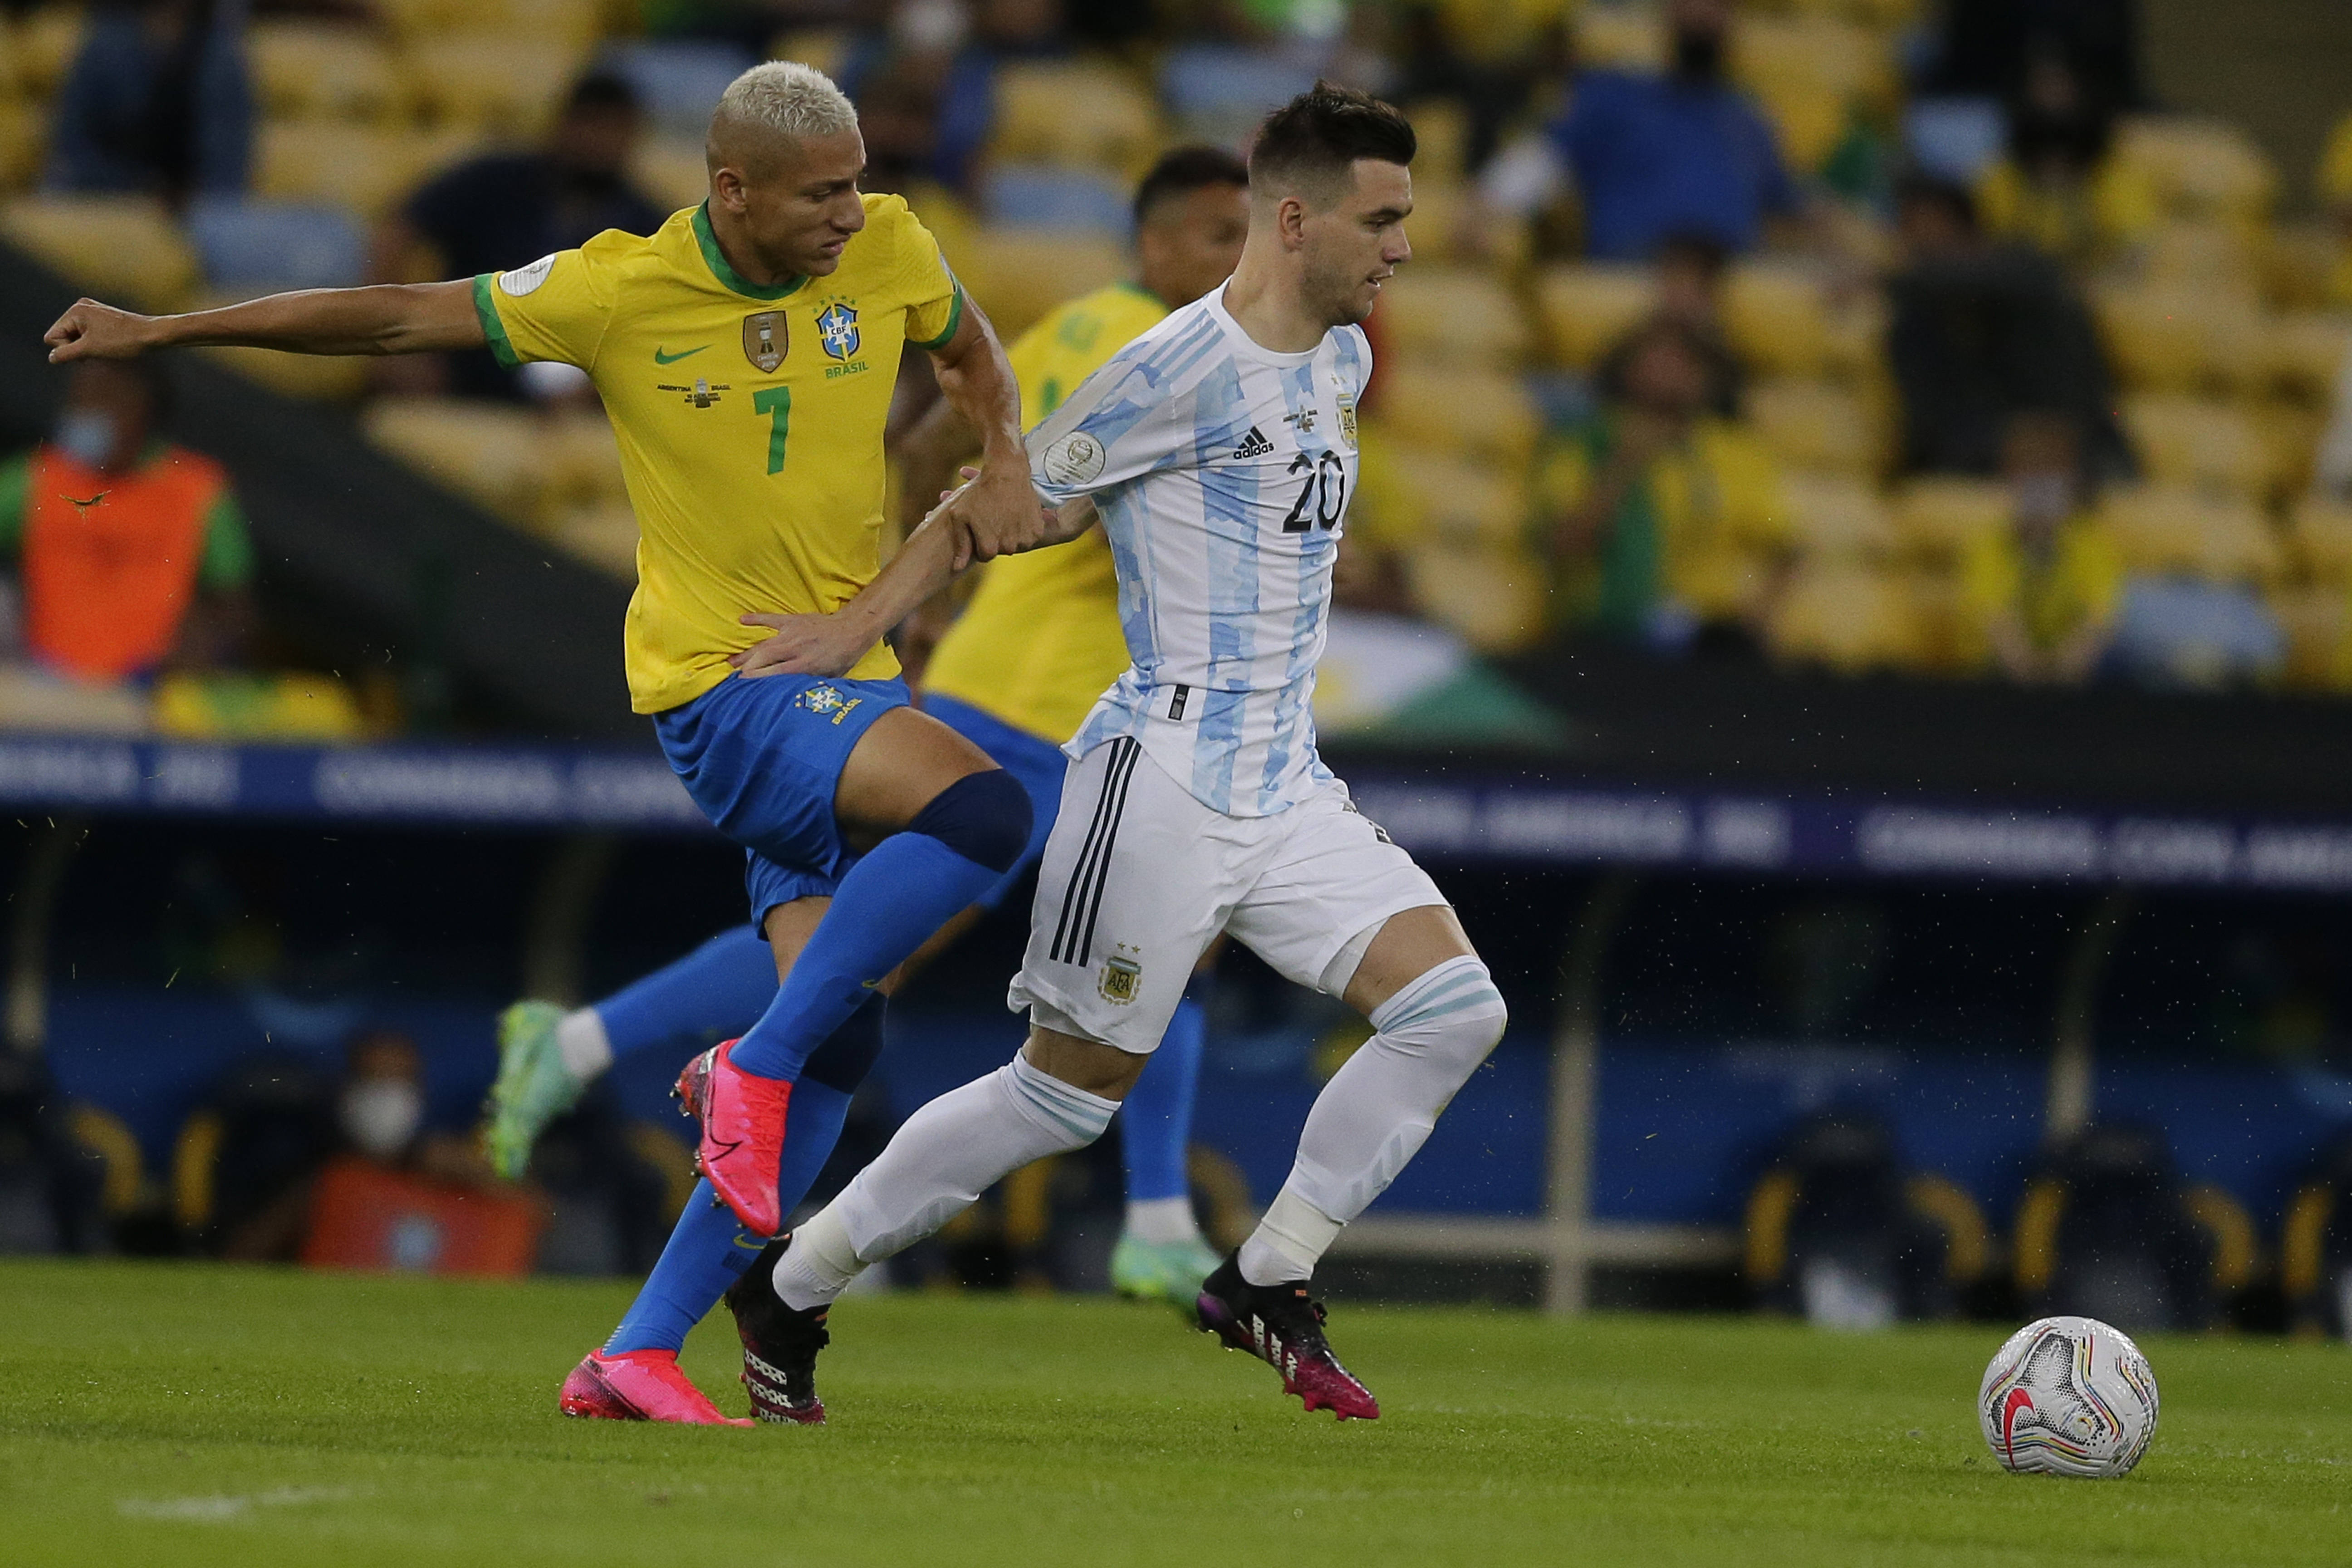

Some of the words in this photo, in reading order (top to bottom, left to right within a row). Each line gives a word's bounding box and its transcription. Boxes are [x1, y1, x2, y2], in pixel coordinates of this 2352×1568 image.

[831, 326, 847, 335] CBF
[825, 362, 869, 379] BRASIL
[753, 386, 791, 475] 7
[1233, 442, 1274, 460] adidas
[1282, 450, 1345, 534] 20
[831, 698, 863, 725] BRASIL
